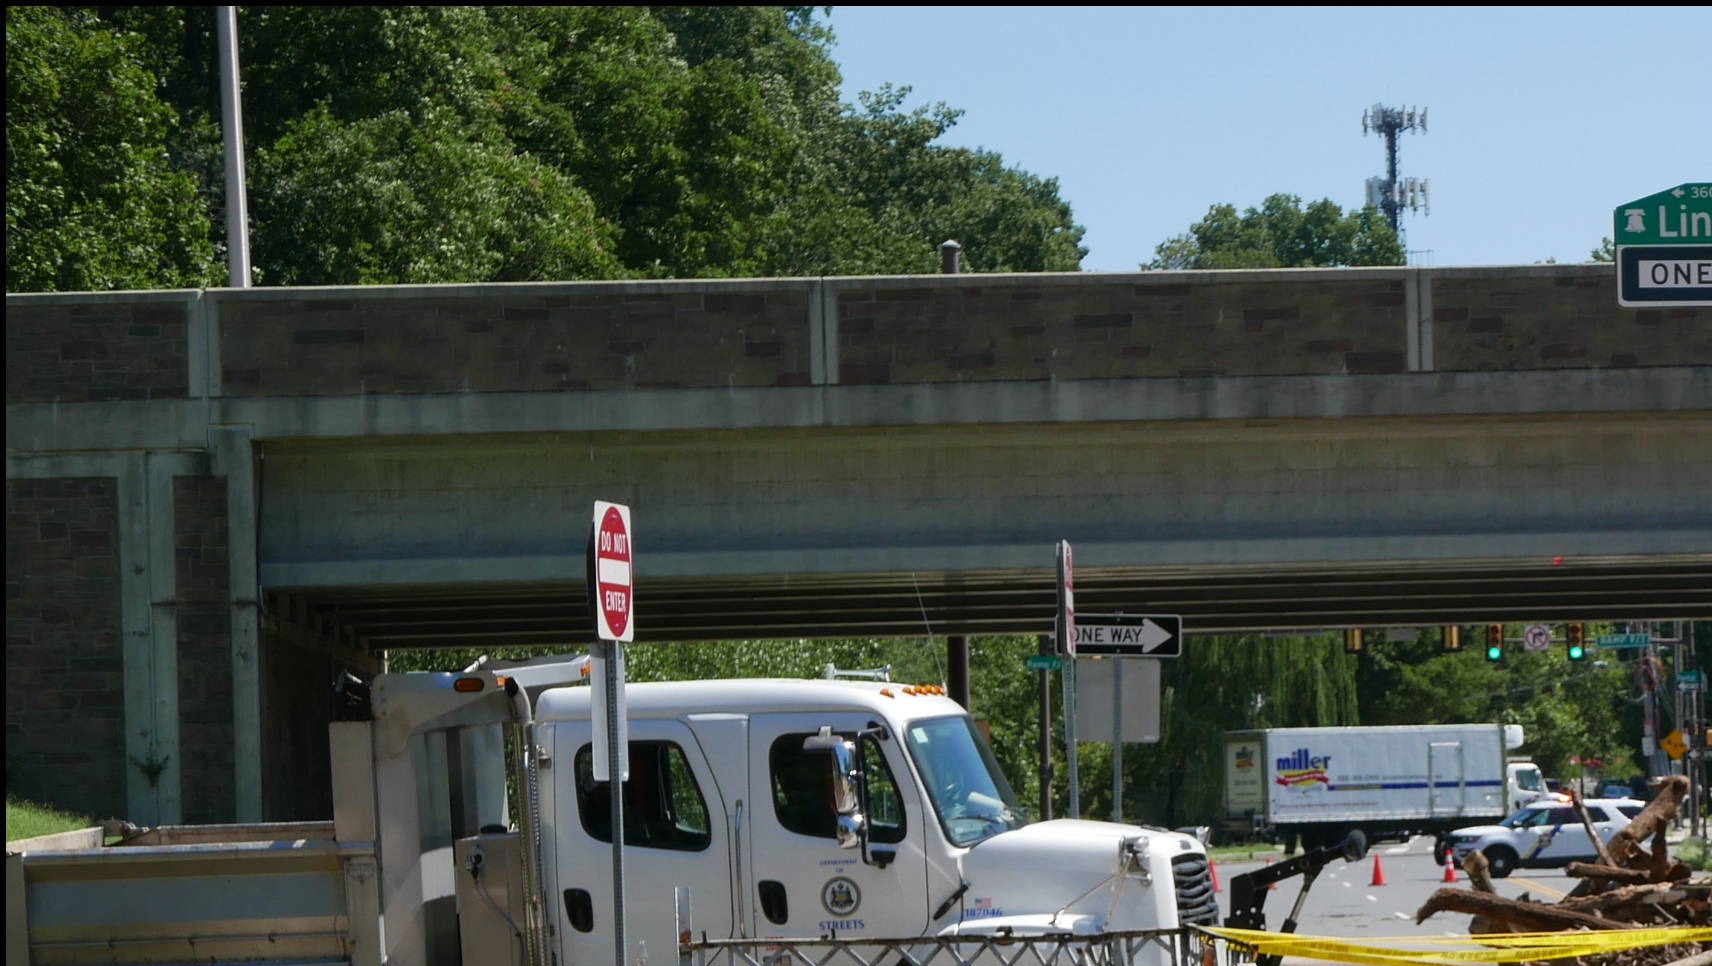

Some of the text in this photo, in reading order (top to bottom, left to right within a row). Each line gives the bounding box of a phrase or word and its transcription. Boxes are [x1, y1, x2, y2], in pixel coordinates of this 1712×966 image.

[1651, 263, 1712, 285] ONE
[601, 530, 626, 554] DO NOT
[605, 590, 626, 613] ENTER
[1110, 628, 1142, 642] WAY
[1276, 748, 1332, 771] miller
[819, 918, 865, 932] STREETS
